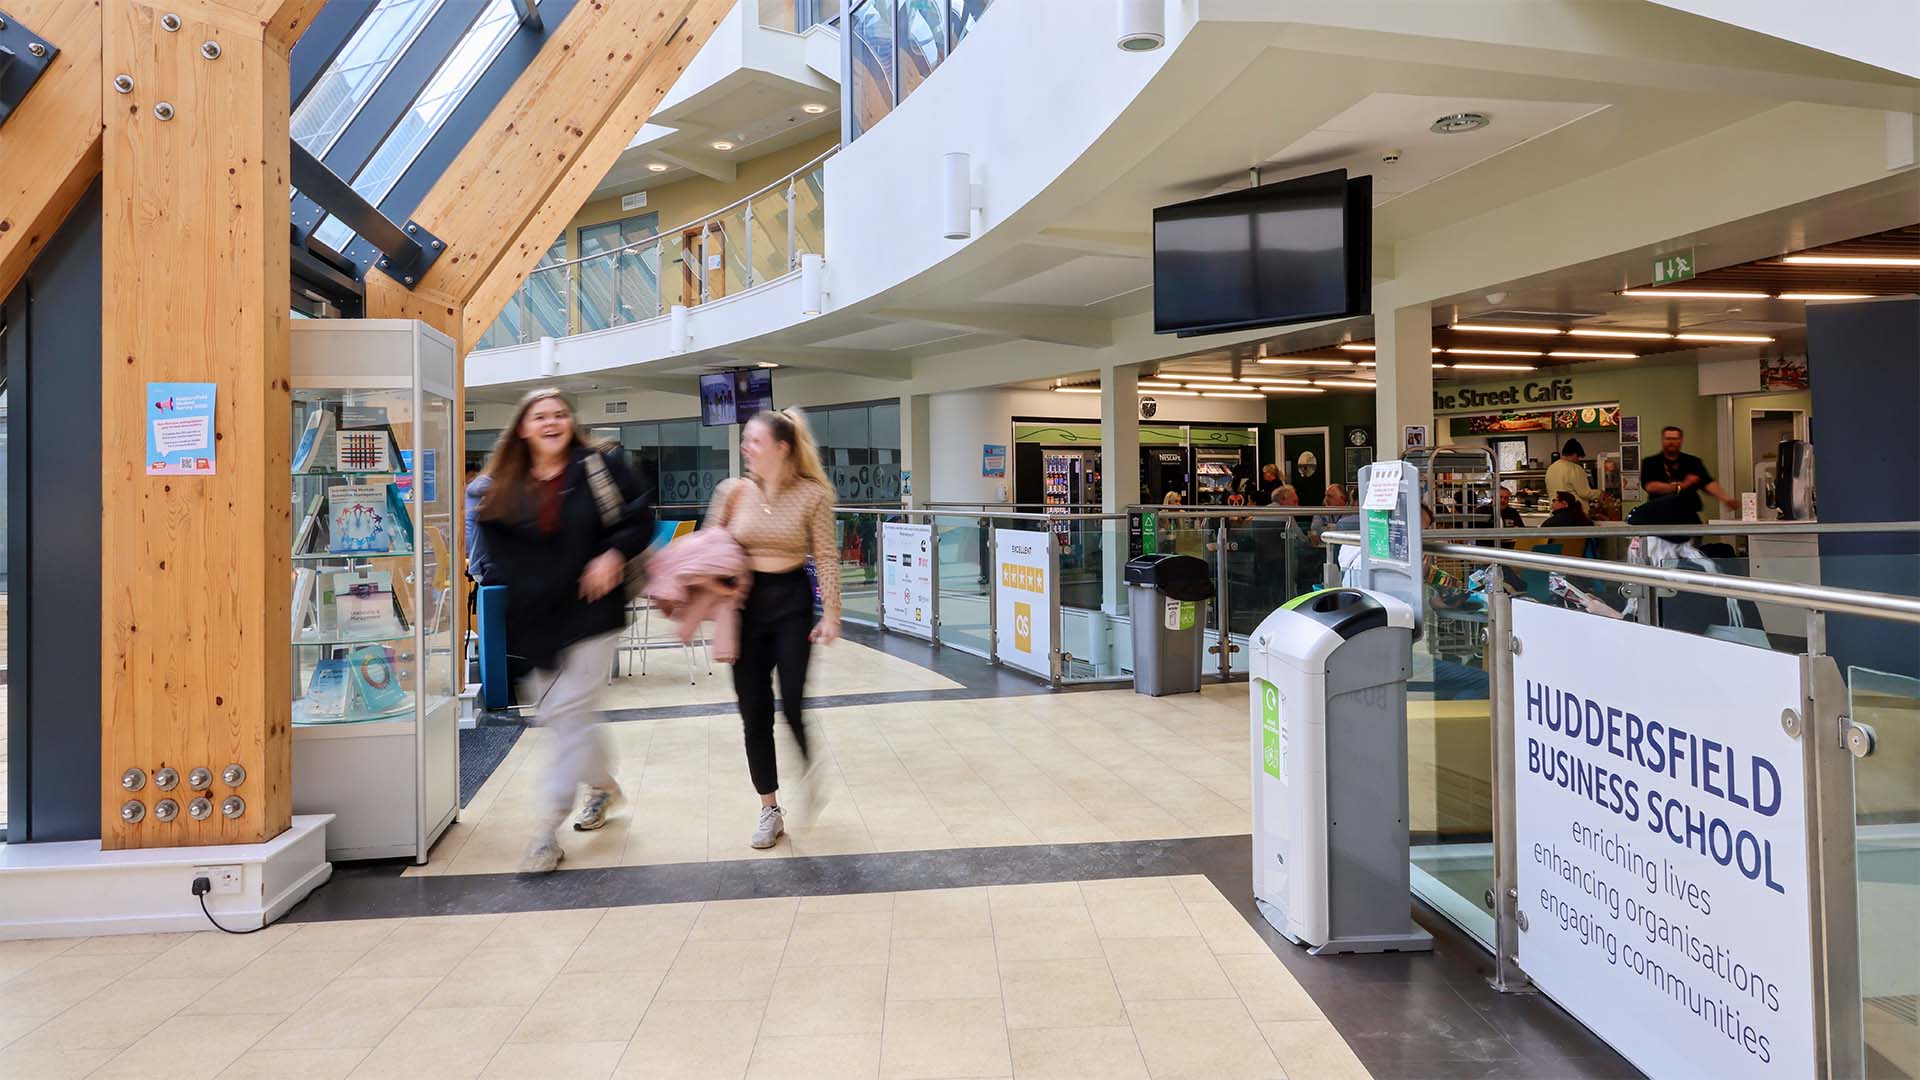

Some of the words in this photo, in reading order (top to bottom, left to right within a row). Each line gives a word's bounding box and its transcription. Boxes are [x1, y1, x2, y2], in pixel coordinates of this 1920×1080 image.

[1433, 391, 1456, 410] he
[1458, 386, 1520, 408] Street
[1523, 378, 1573, 403] Café
[1012, 545, 1032, 555] EXCELLENT
[1016, 614, 1029, 639] QS
[1526, 678, 1782, 817] HUDDERSFIELD
[1528, 737, 1640, 823] BUSINESS
[1647, 789, 1786, 895] SCHOOL
[1572, 820, 1657, 895] enriching
[1663, 857, 1712, 916] lives
[1533, 842, 1620, 920] enhancing
[1625, 897, 1780, 1013] organisations
[1540, 888, 1617, 966] engaging
[1622, 943, 1771, 1064] communities
